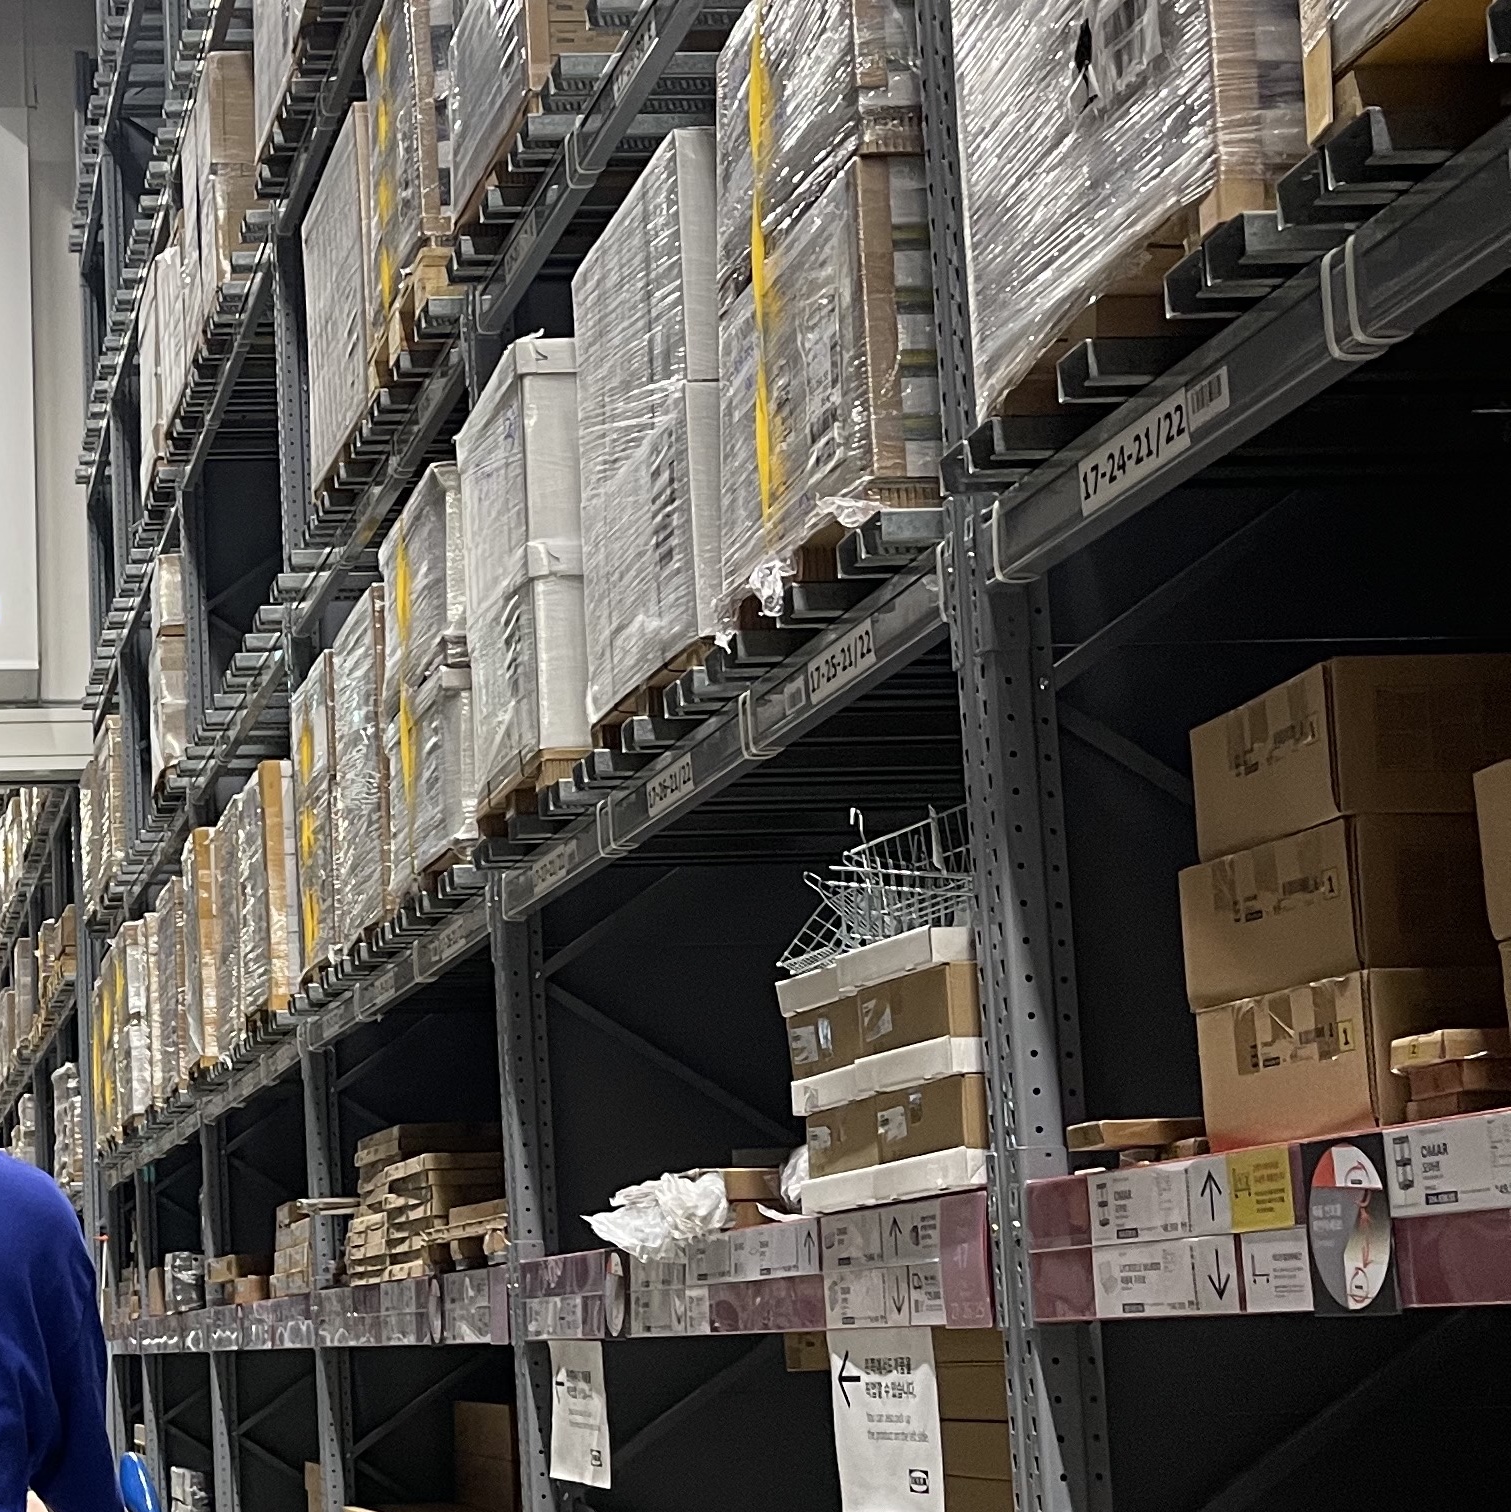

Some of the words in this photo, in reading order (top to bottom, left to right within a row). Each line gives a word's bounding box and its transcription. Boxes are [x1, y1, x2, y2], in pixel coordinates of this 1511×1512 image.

[1082, 404, 1185, 501] 17-24-21/22
[810, 630, 872, 693] 17-25-21/22
[1328, 875, 1335, 893] 1
[1342, 1028, 1350, 1046] 1
[1420, 1142, 1449, 1158] OMAR
